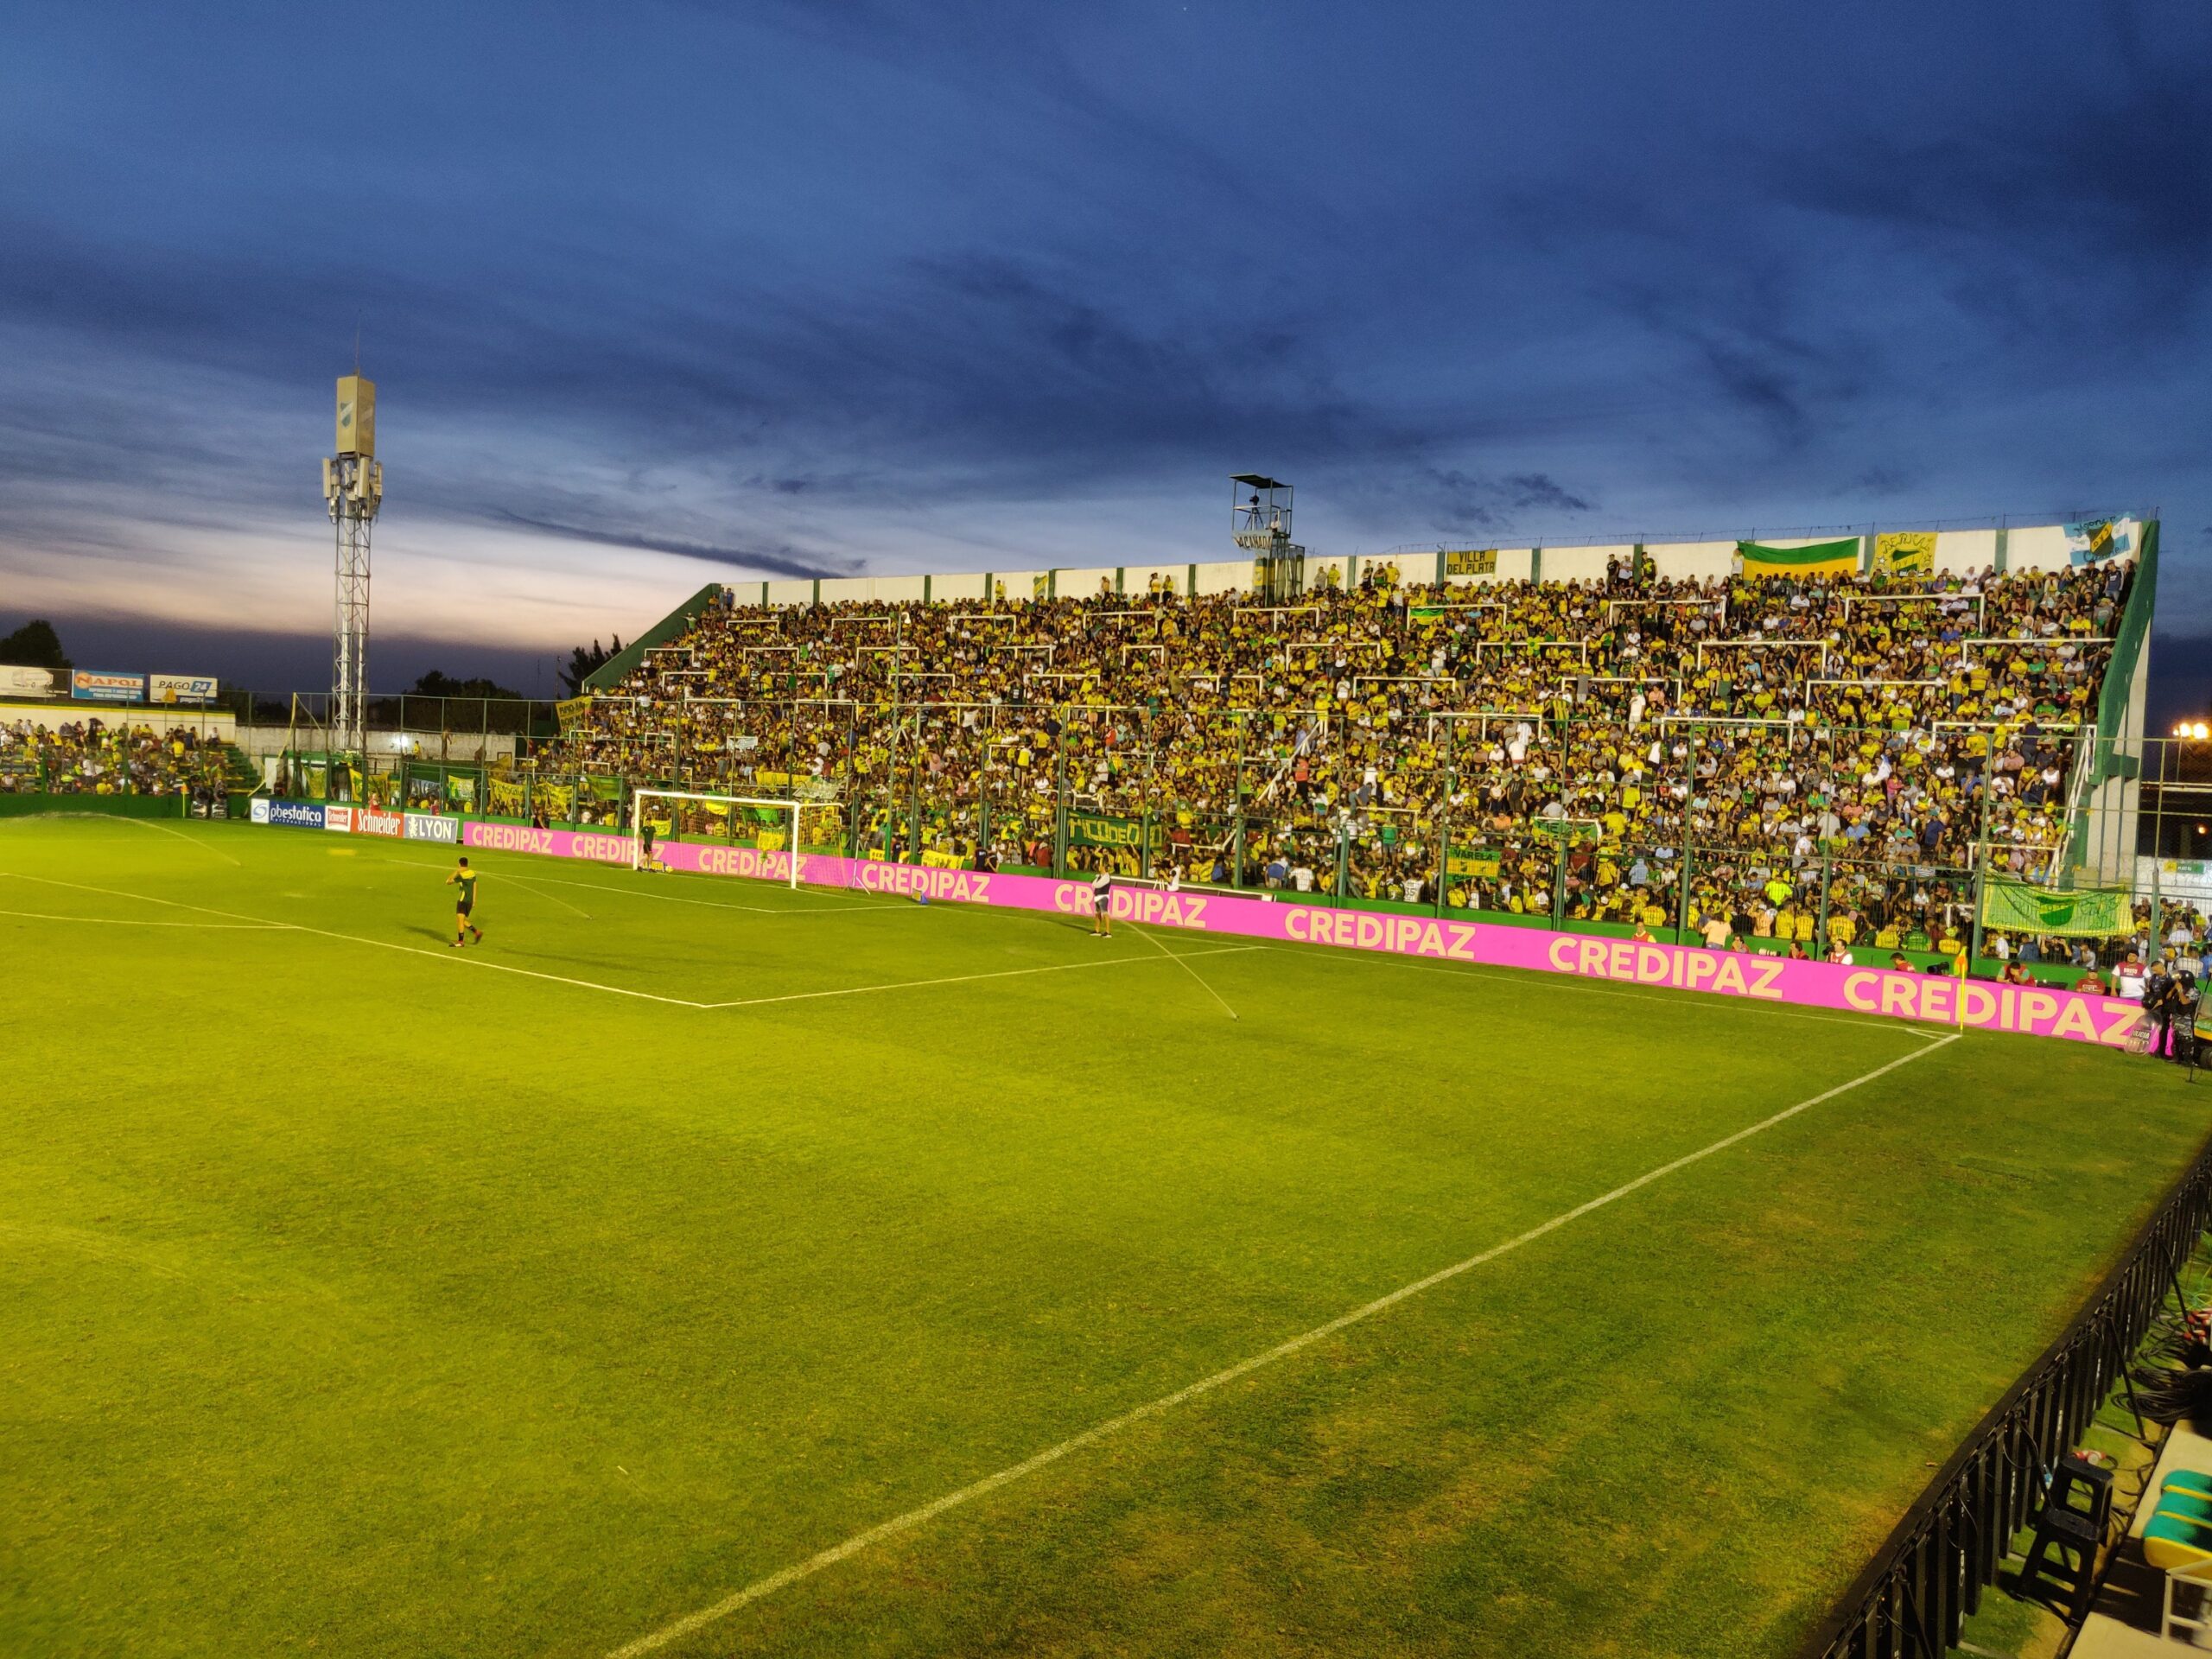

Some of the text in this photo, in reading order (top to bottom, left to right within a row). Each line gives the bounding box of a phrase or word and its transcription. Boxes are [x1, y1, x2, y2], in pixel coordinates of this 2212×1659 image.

[1447, 562, 1495, 575] DEL PLATA
[1459, 551, 1485, 563] VILLA
[159, 680, 208, 691] PAGO 24
[270, 803, 322, 823] pbestatica
[357, 808, 401, 836] Schneider
[418, 819, 453, 840] LYON
[472, 825, 554, 855] CREDIPAZ
[698, 848, 808, 880] CREDIPAZ
[1453, 849, 1494, 860] VARELA
[861, 863, 990, 903] CREDIPAZ
[1054, 883, 1207, 928] CRDIPAZ
[1285, 908, 1476, 959] CREDIPAZ
[1549, 937, 1784, 998] CREDIPAZ
[1843, 971, 2145, 1047] CREDIPAZ
